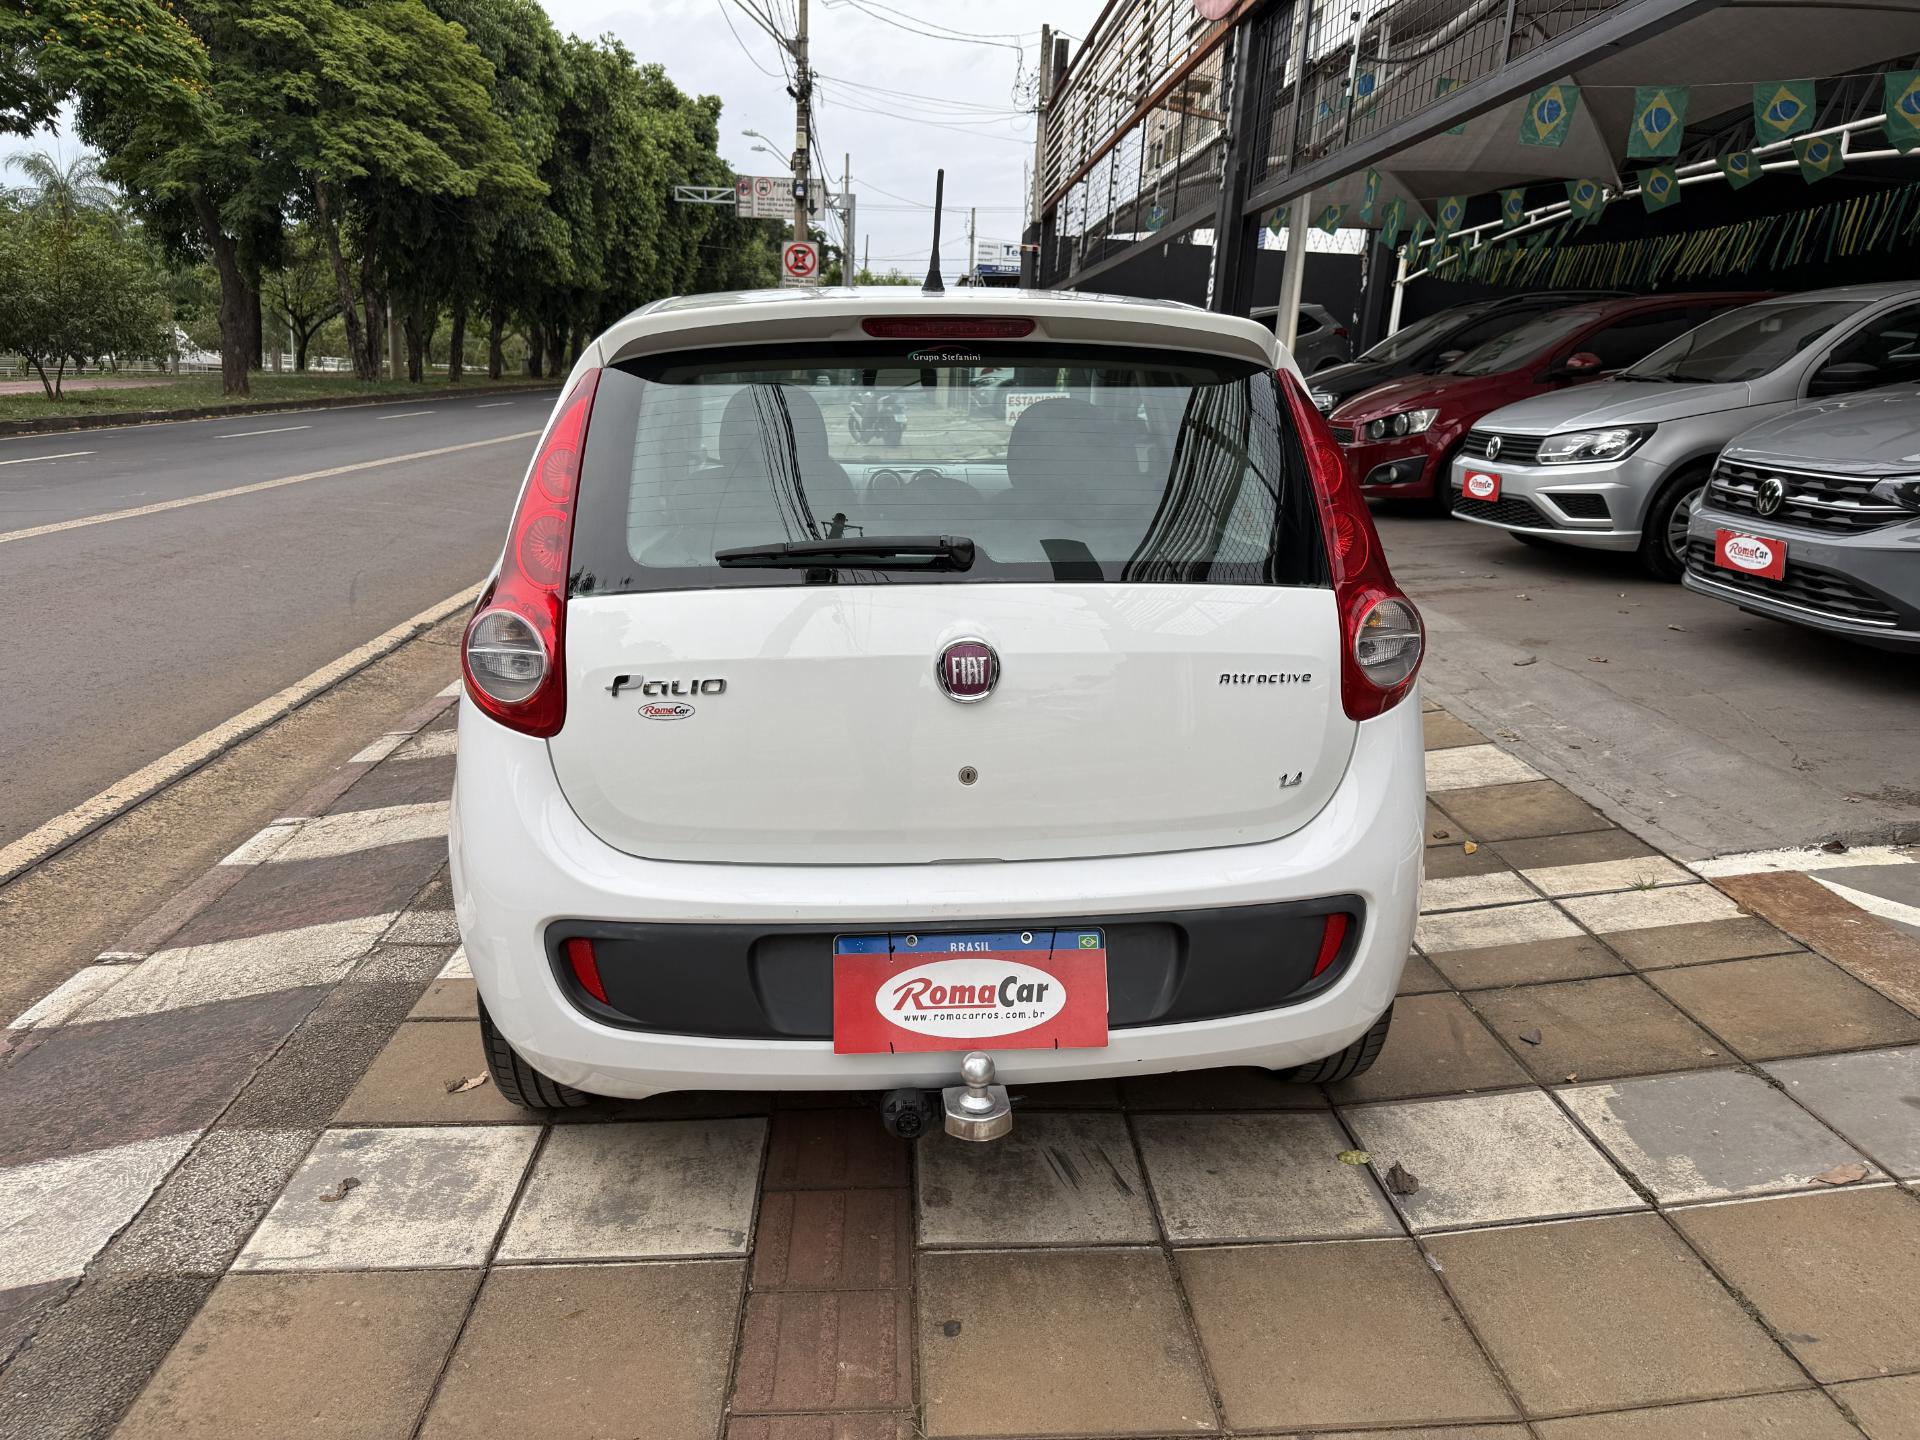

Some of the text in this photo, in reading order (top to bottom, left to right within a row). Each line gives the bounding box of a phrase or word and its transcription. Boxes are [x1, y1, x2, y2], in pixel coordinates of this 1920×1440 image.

[912, 353, 981, 361] Grupo Stefanini
[1729, 542, 1769, 559] RomaCar
[951, 656, 988, 685] FIAT
[1219, 672, 1312, 684] Attractive
[642, 705, 691, 715] RomaCar
[950, 942, 992, 952] BRASIL
[893, 975, 1049, 1011] RomaCar
[904, 1009, 1046, 1022] www.romacarros.com.br
